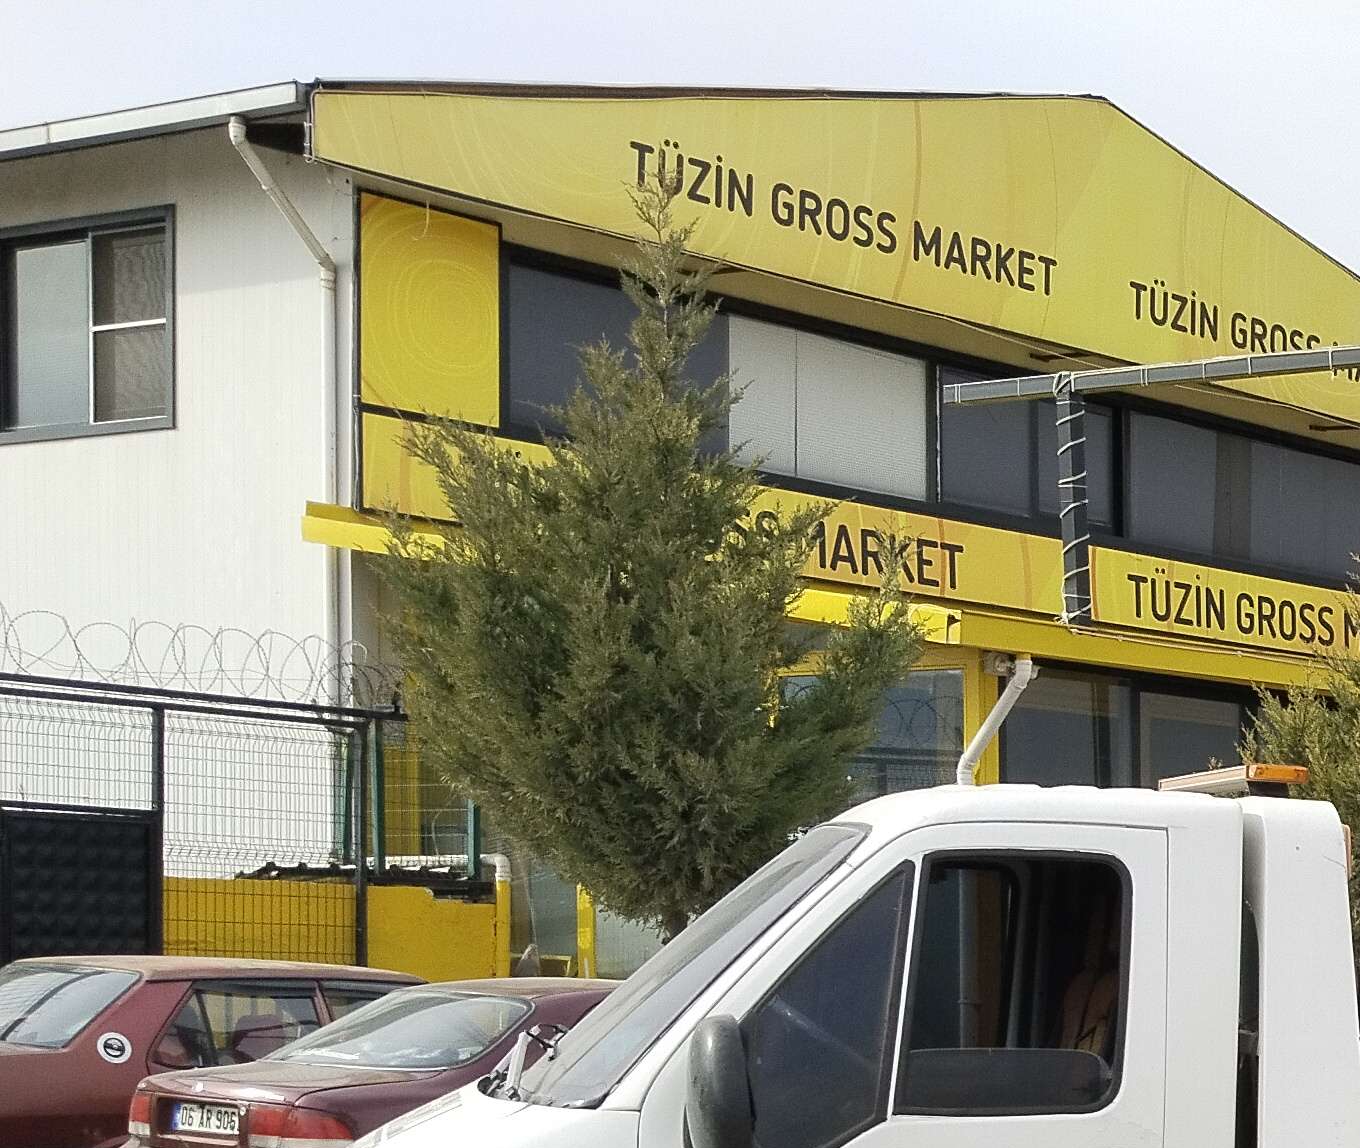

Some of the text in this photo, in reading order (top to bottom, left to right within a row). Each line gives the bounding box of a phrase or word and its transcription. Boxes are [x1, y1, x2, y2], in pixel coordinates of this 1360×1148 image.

[629, 139, 1058, 296] TÜZİN GROSS MARKET
[1129, 279, 1219, 342] TÜZİN
[1127, 567, 1226, 632] TÜZİN
[1236, 592, 1335, 647] GROSS
